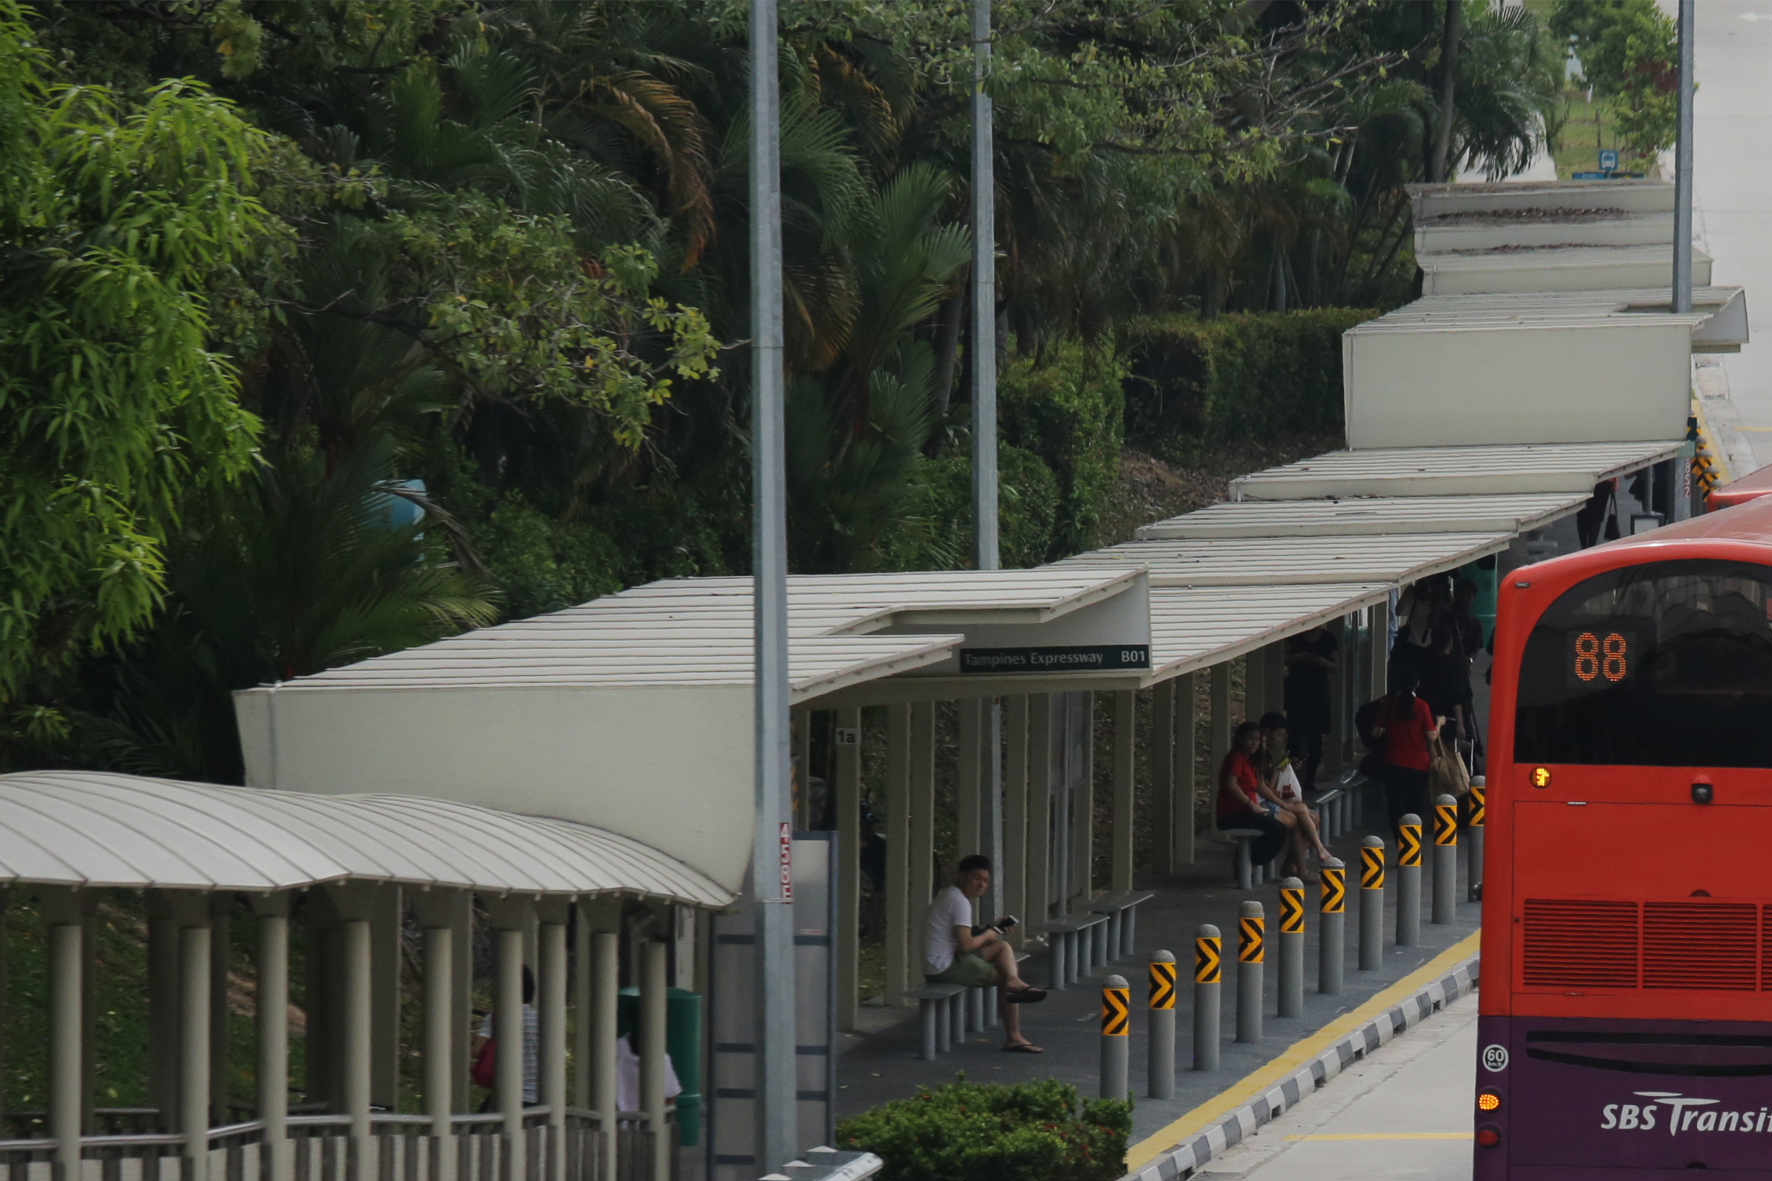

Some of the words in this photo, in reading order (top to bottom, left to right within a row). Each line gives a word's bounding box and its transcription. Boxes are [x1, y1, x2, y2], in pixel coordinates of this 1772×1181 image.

[963, 653, 1027, 667] Tampines
[1030, 652, 1104, 666] Expressway
[1121, 650, 1146, 663] B01
[1575, 632, 1627, 682] 88
[838, 730, 856, 743] 1a
[1486, 1049, 1505, 1062] 60
[1600, 1103, 1658, 1131] SBS
